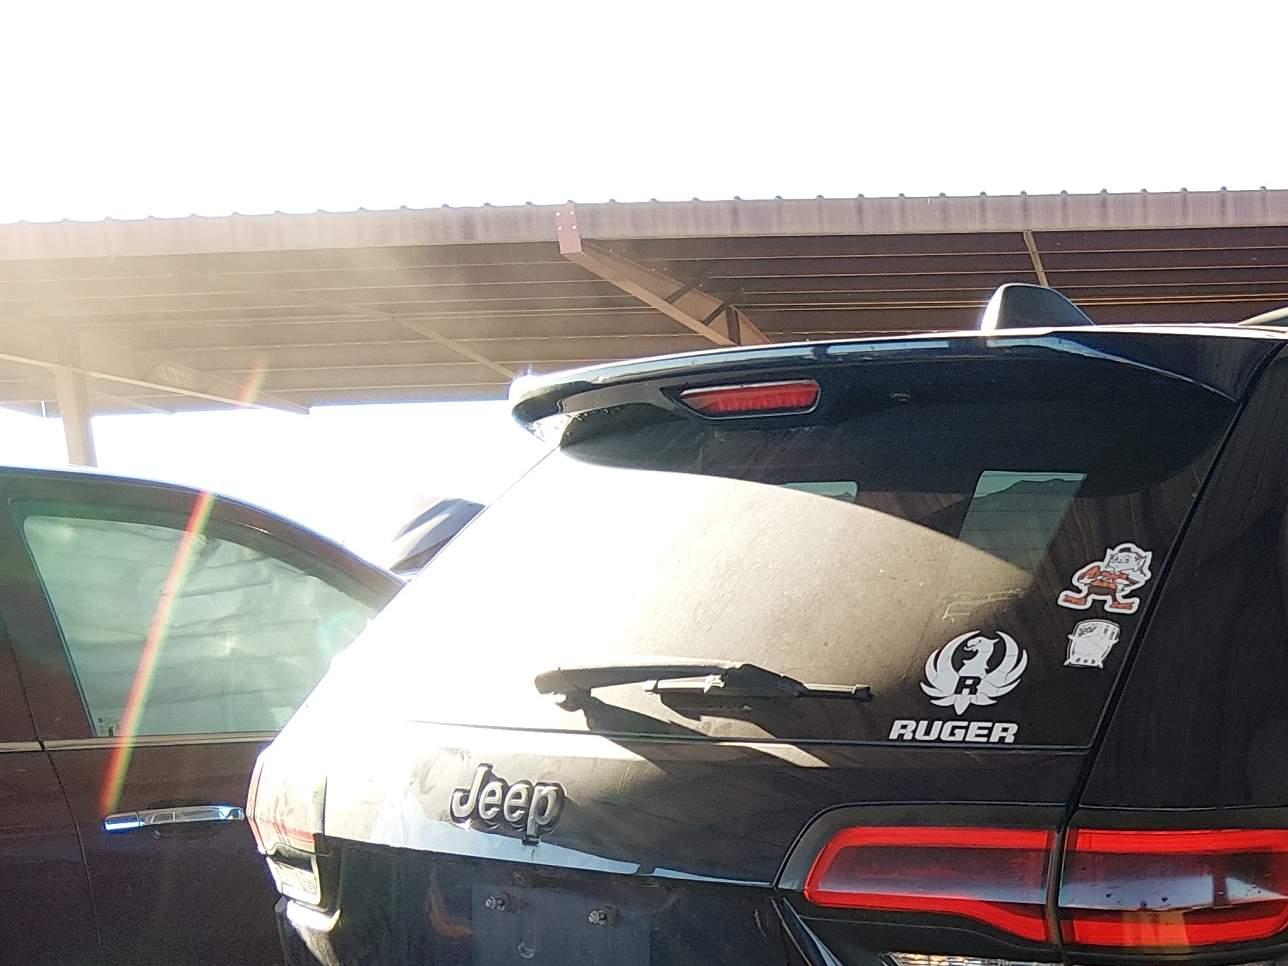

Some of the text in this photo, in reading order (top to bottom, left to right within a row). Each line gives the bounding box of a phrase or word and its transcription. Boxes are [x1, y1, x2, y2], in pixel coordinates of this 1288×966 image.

[955, 676, 981, 695] R
[888, 719, 1019, 744] RUGER
[451, 763, 566, 845] Jeep
